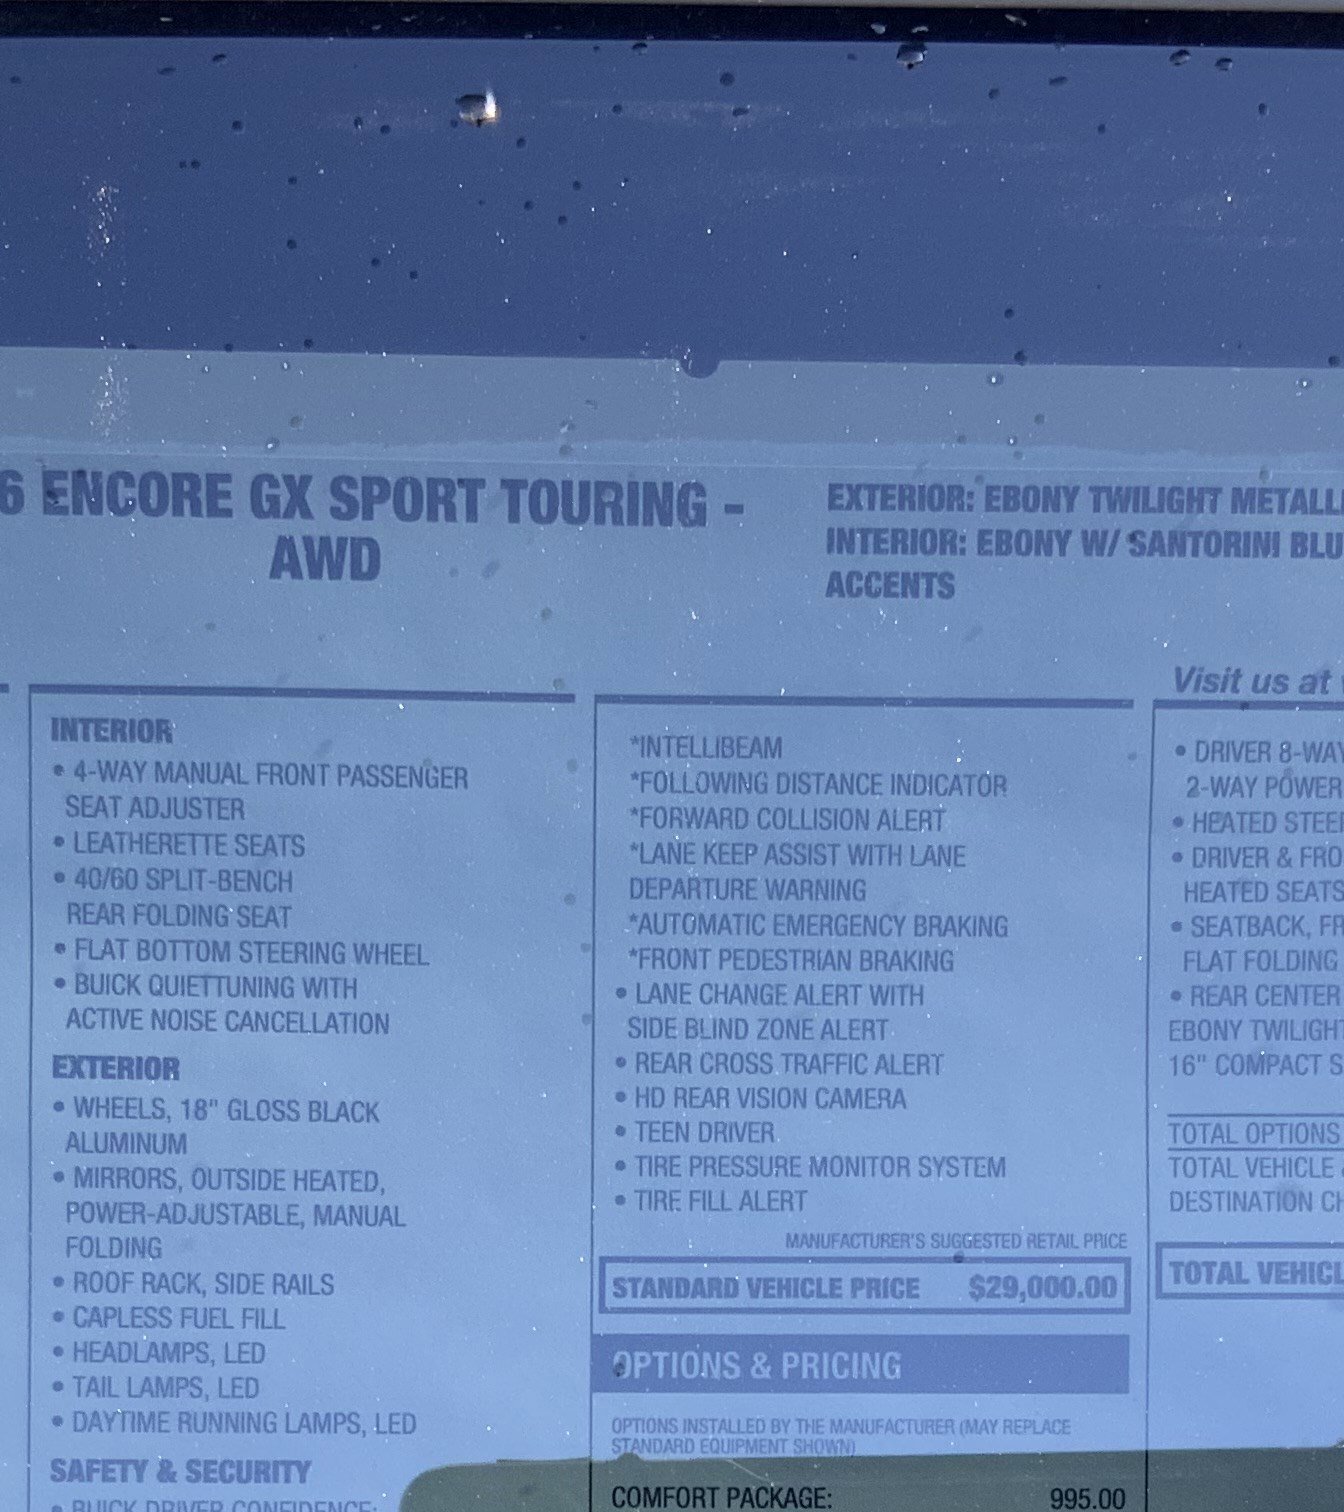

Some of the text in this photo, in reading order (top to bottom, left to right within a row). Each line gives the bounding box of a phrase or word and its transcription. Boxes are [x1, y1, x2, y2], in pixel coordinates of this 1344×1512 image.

[42, 468, 232, 518] ENCORE
[250, 473, 313, 519] GX
[330, 475, 485, 522] SPORT
[500, 478, 706, 527] TOURING
[828, 483, 974, 512] EXTERIOR:
[985, 485, 1080, 513] EBONY
[1089, 486, 1222, 514] TWILIGHT
[827, 527, 966, 555] INTERIOR:
[978, 529, 1072, 557] EBONY
[1081, 529, 1120, 557] W/
[1127, 529, 1280, 558] SANTORINI
[270, 536, 380, 581] AWD
[826, 570, 955, 599] ACCENTS
[1175, 666, 1242, 694] Visit
[1252, 674, 1289, 694] us
[1299, 669, 1332, 694] at
[52, 717, 172, 743] INTERIOR
[74, 831, 305, 857] LEATHERETTE SEATS
[75, 866, 292, 893] 40/60 SPLIT-BENCH
[53, 1055, 179, 1080] EXTERIOR
[1216, 1053, 1322, 1076] COMPACT
[636, 1120, 774, 1143] TEEN DRIVER
[1169, 1260, 1250, 1285] TOTAL
[613, 1274, 1117, 1303] STANDARD VEHICLE PRICE $29,000.00
[51, 1459, 311, 1484] SAFETY & SECURITY
[612, 1486, 1126, 1510] COMFORT PACKAGE: 995.00
